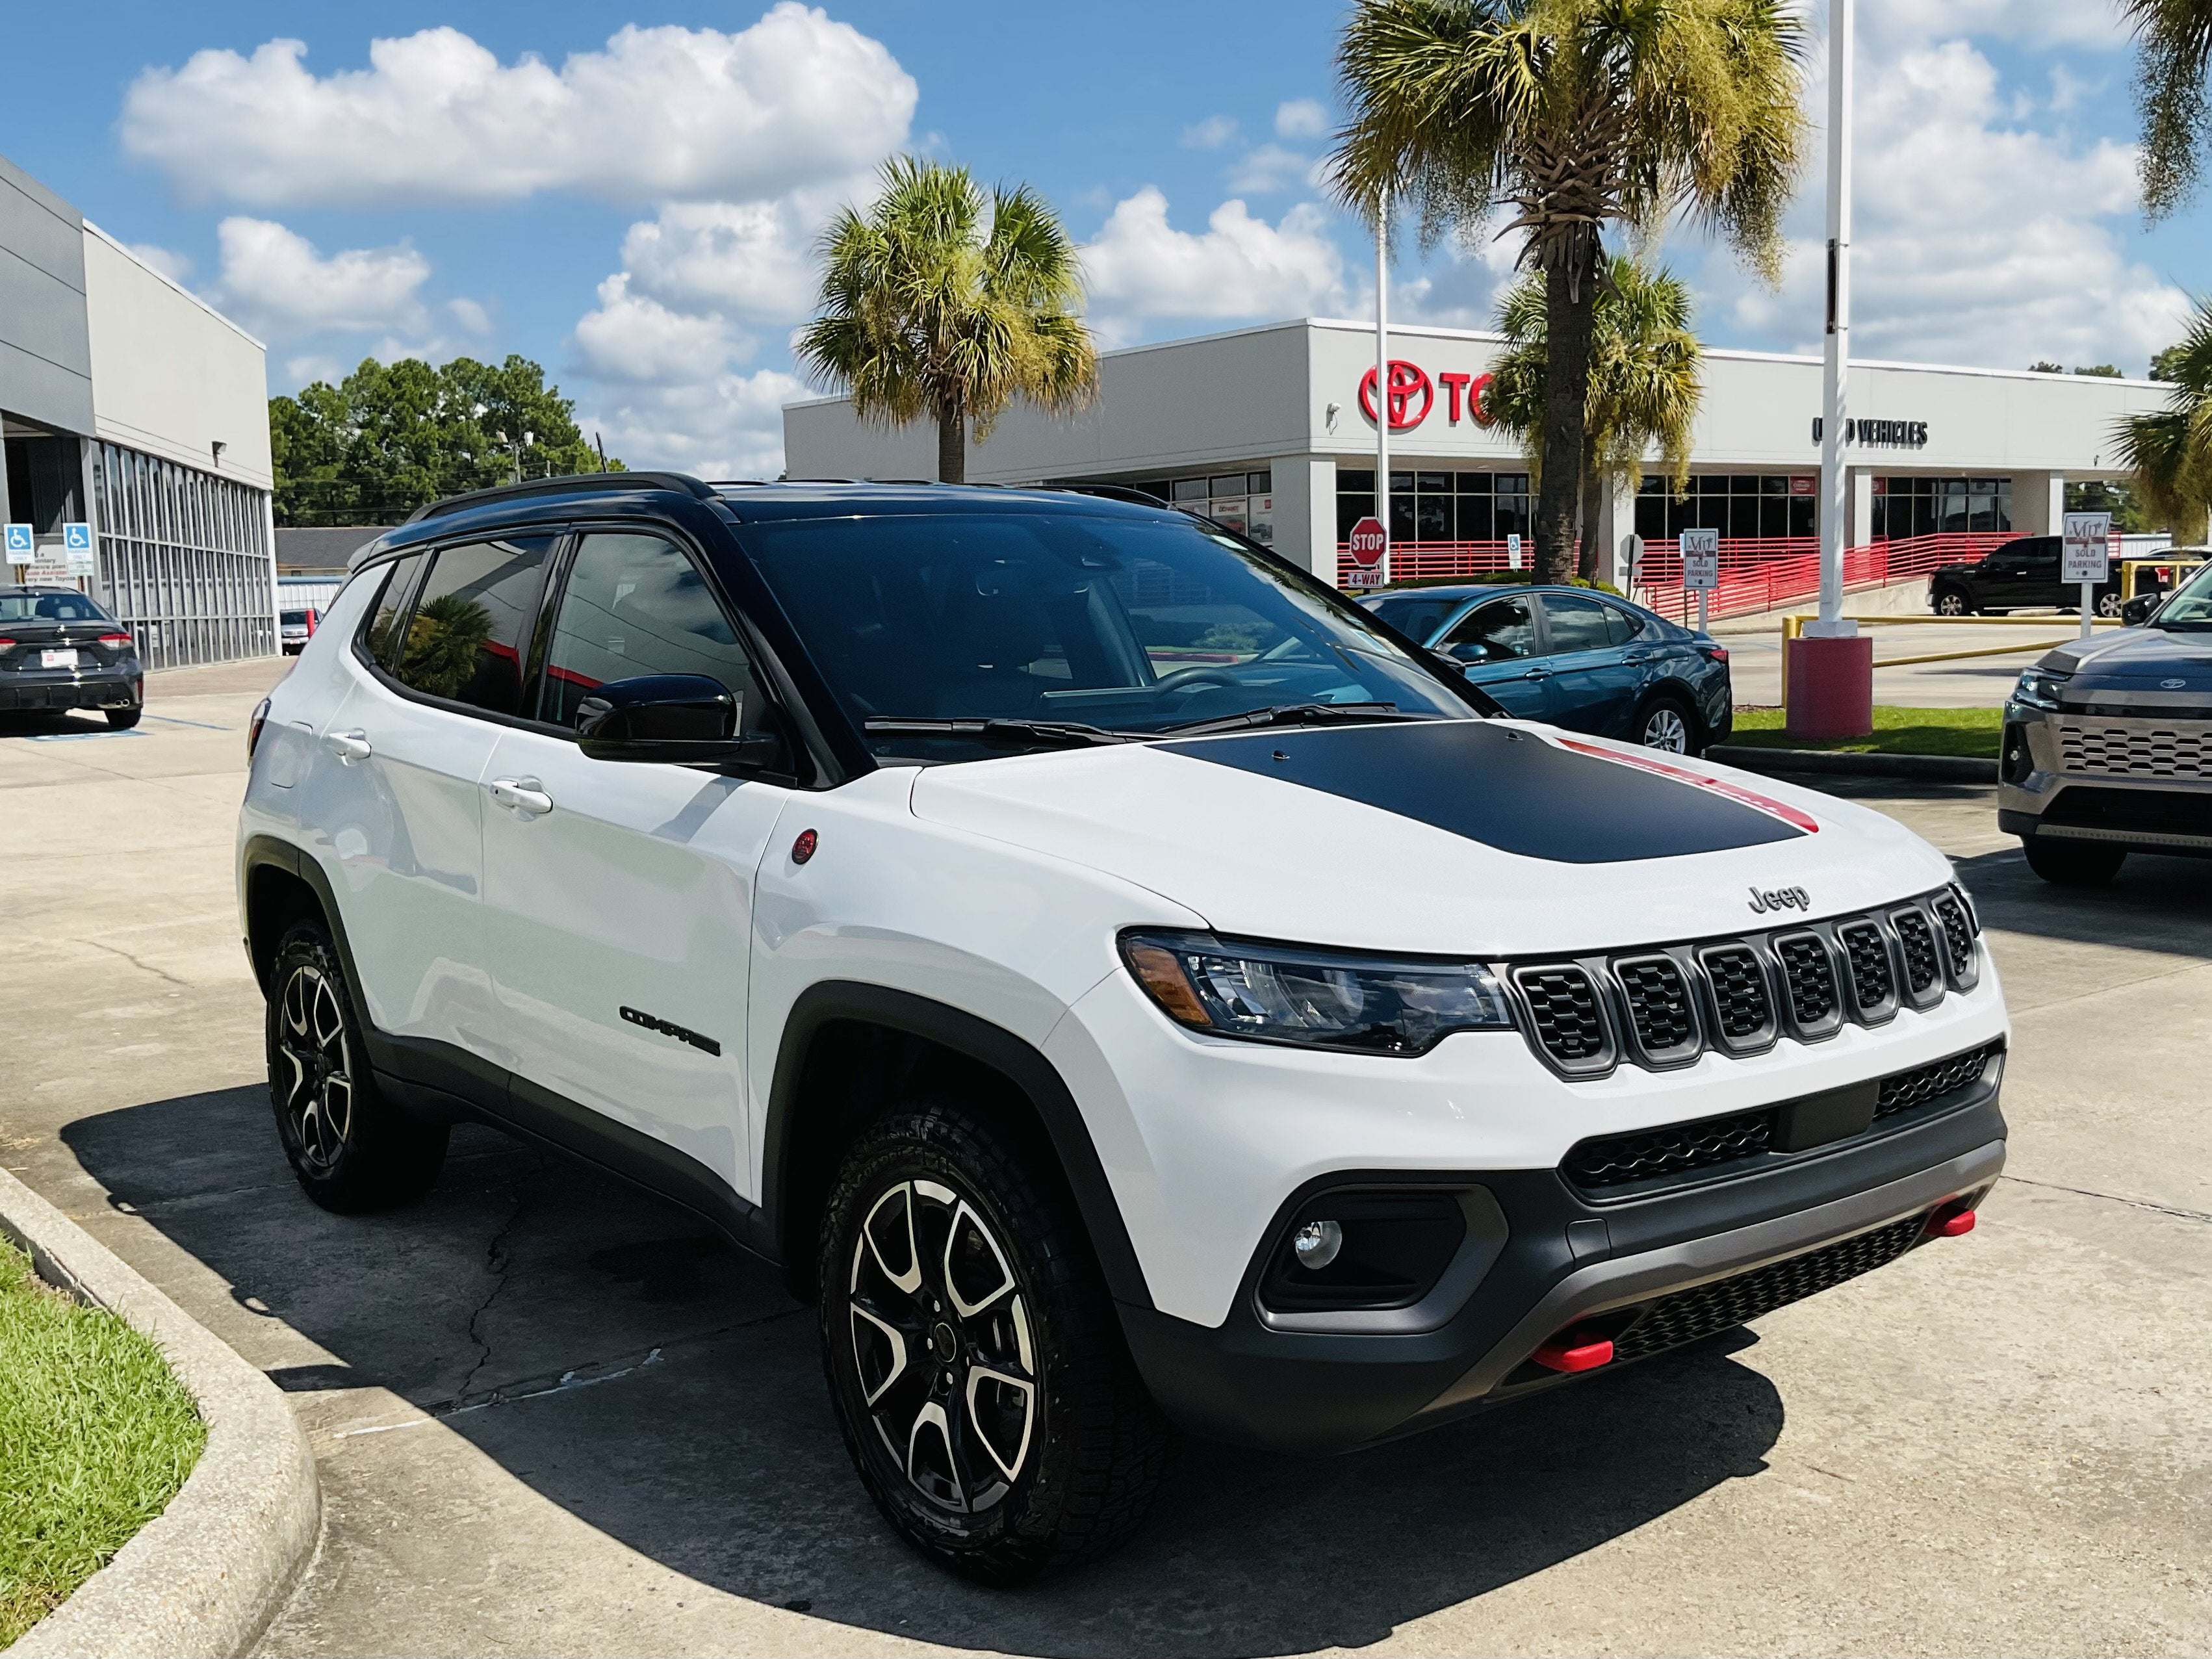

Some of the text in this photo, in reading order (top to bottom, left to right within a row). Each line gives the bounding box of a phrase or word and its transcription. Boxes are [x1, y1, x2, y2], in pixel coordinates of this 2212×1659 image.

[1812, 417, 1928, 444] UD VEHICLES
[1352, 534, 1383, 551] STOP
[2068, 560, 2102, 569] PARKING
[1352, 574, 1380, 585] 4-WAY
[1747, 886, 1810, 914] Jeep
